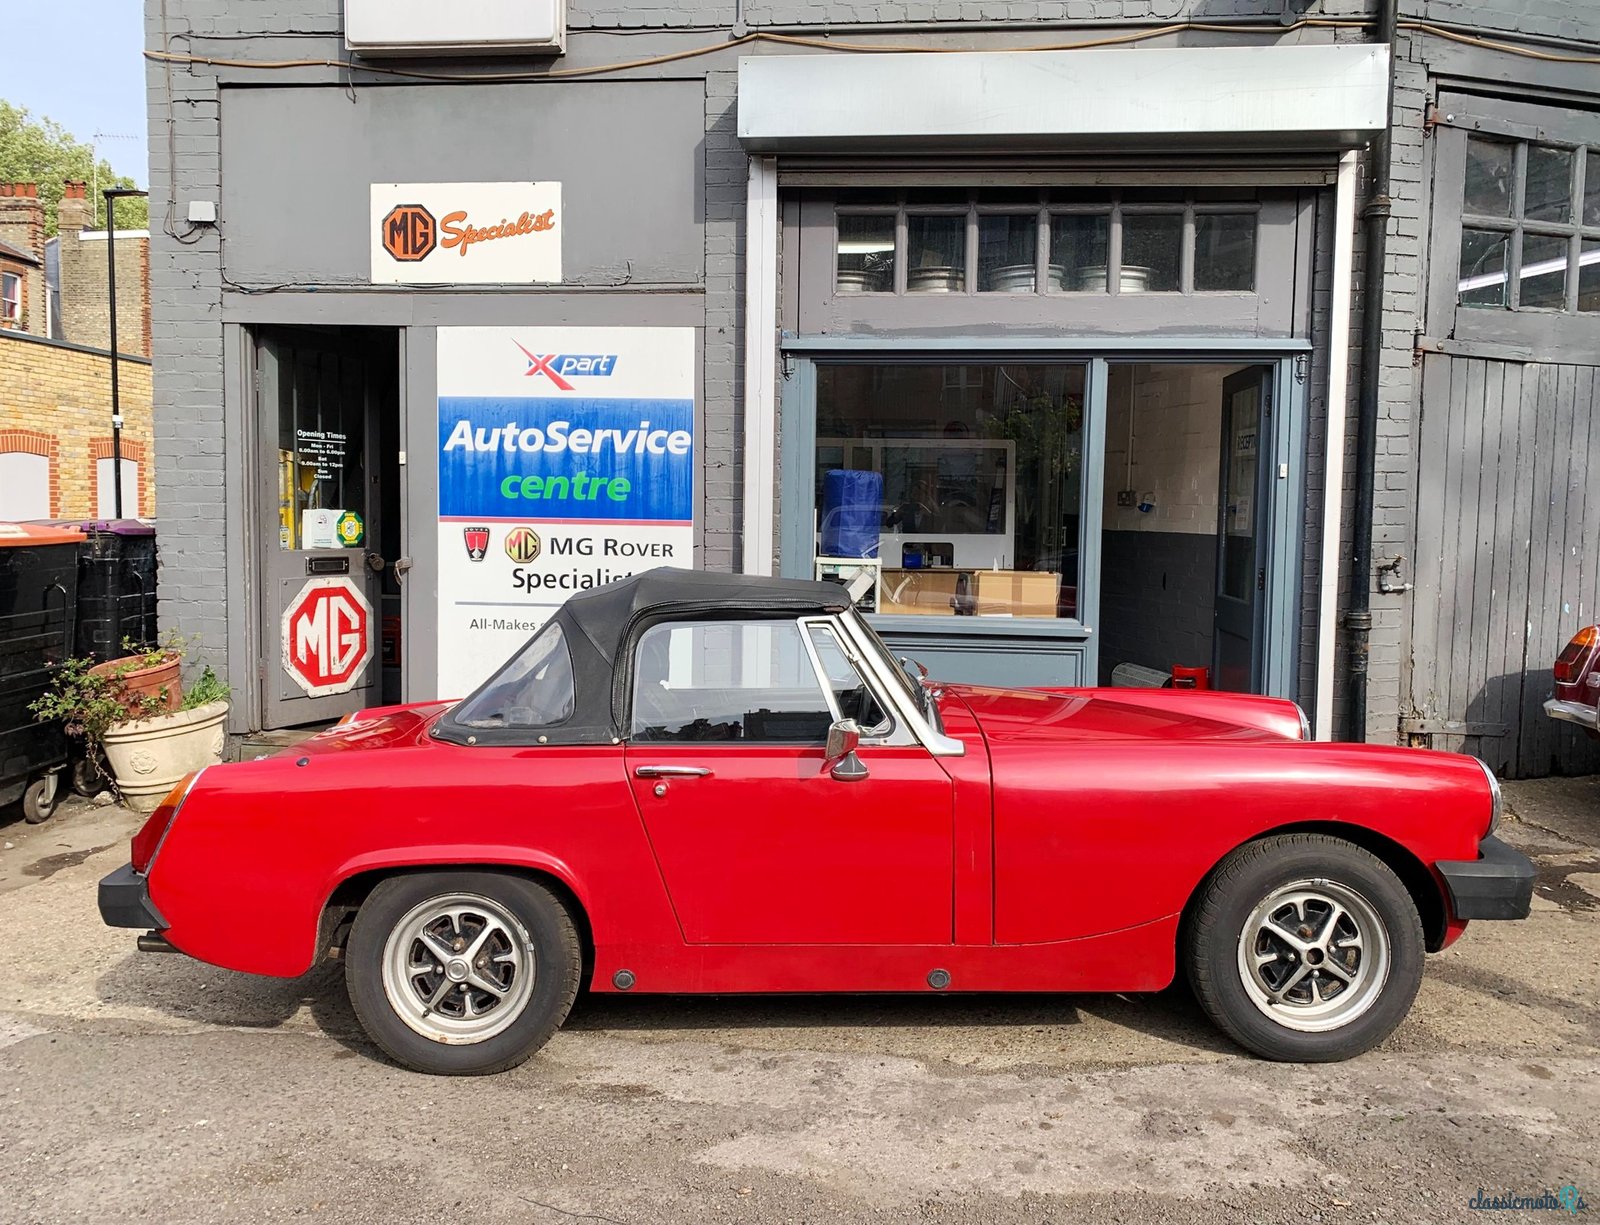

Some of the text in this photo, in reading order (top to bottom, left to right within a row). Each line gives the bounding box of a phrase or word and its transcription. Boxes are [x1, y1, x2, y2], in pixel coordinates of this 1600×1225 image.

[440, 209, 555, 257] Specialist
[297, 429, 346, 440] Opening Times
[443, 420, 692, 455] AutoService
[500, 470, 631, 502] centre
[550, 537, 593, 556] MG
[296, 596, 360, 678] MG
[469, 618, 536, 631] All-Makes
